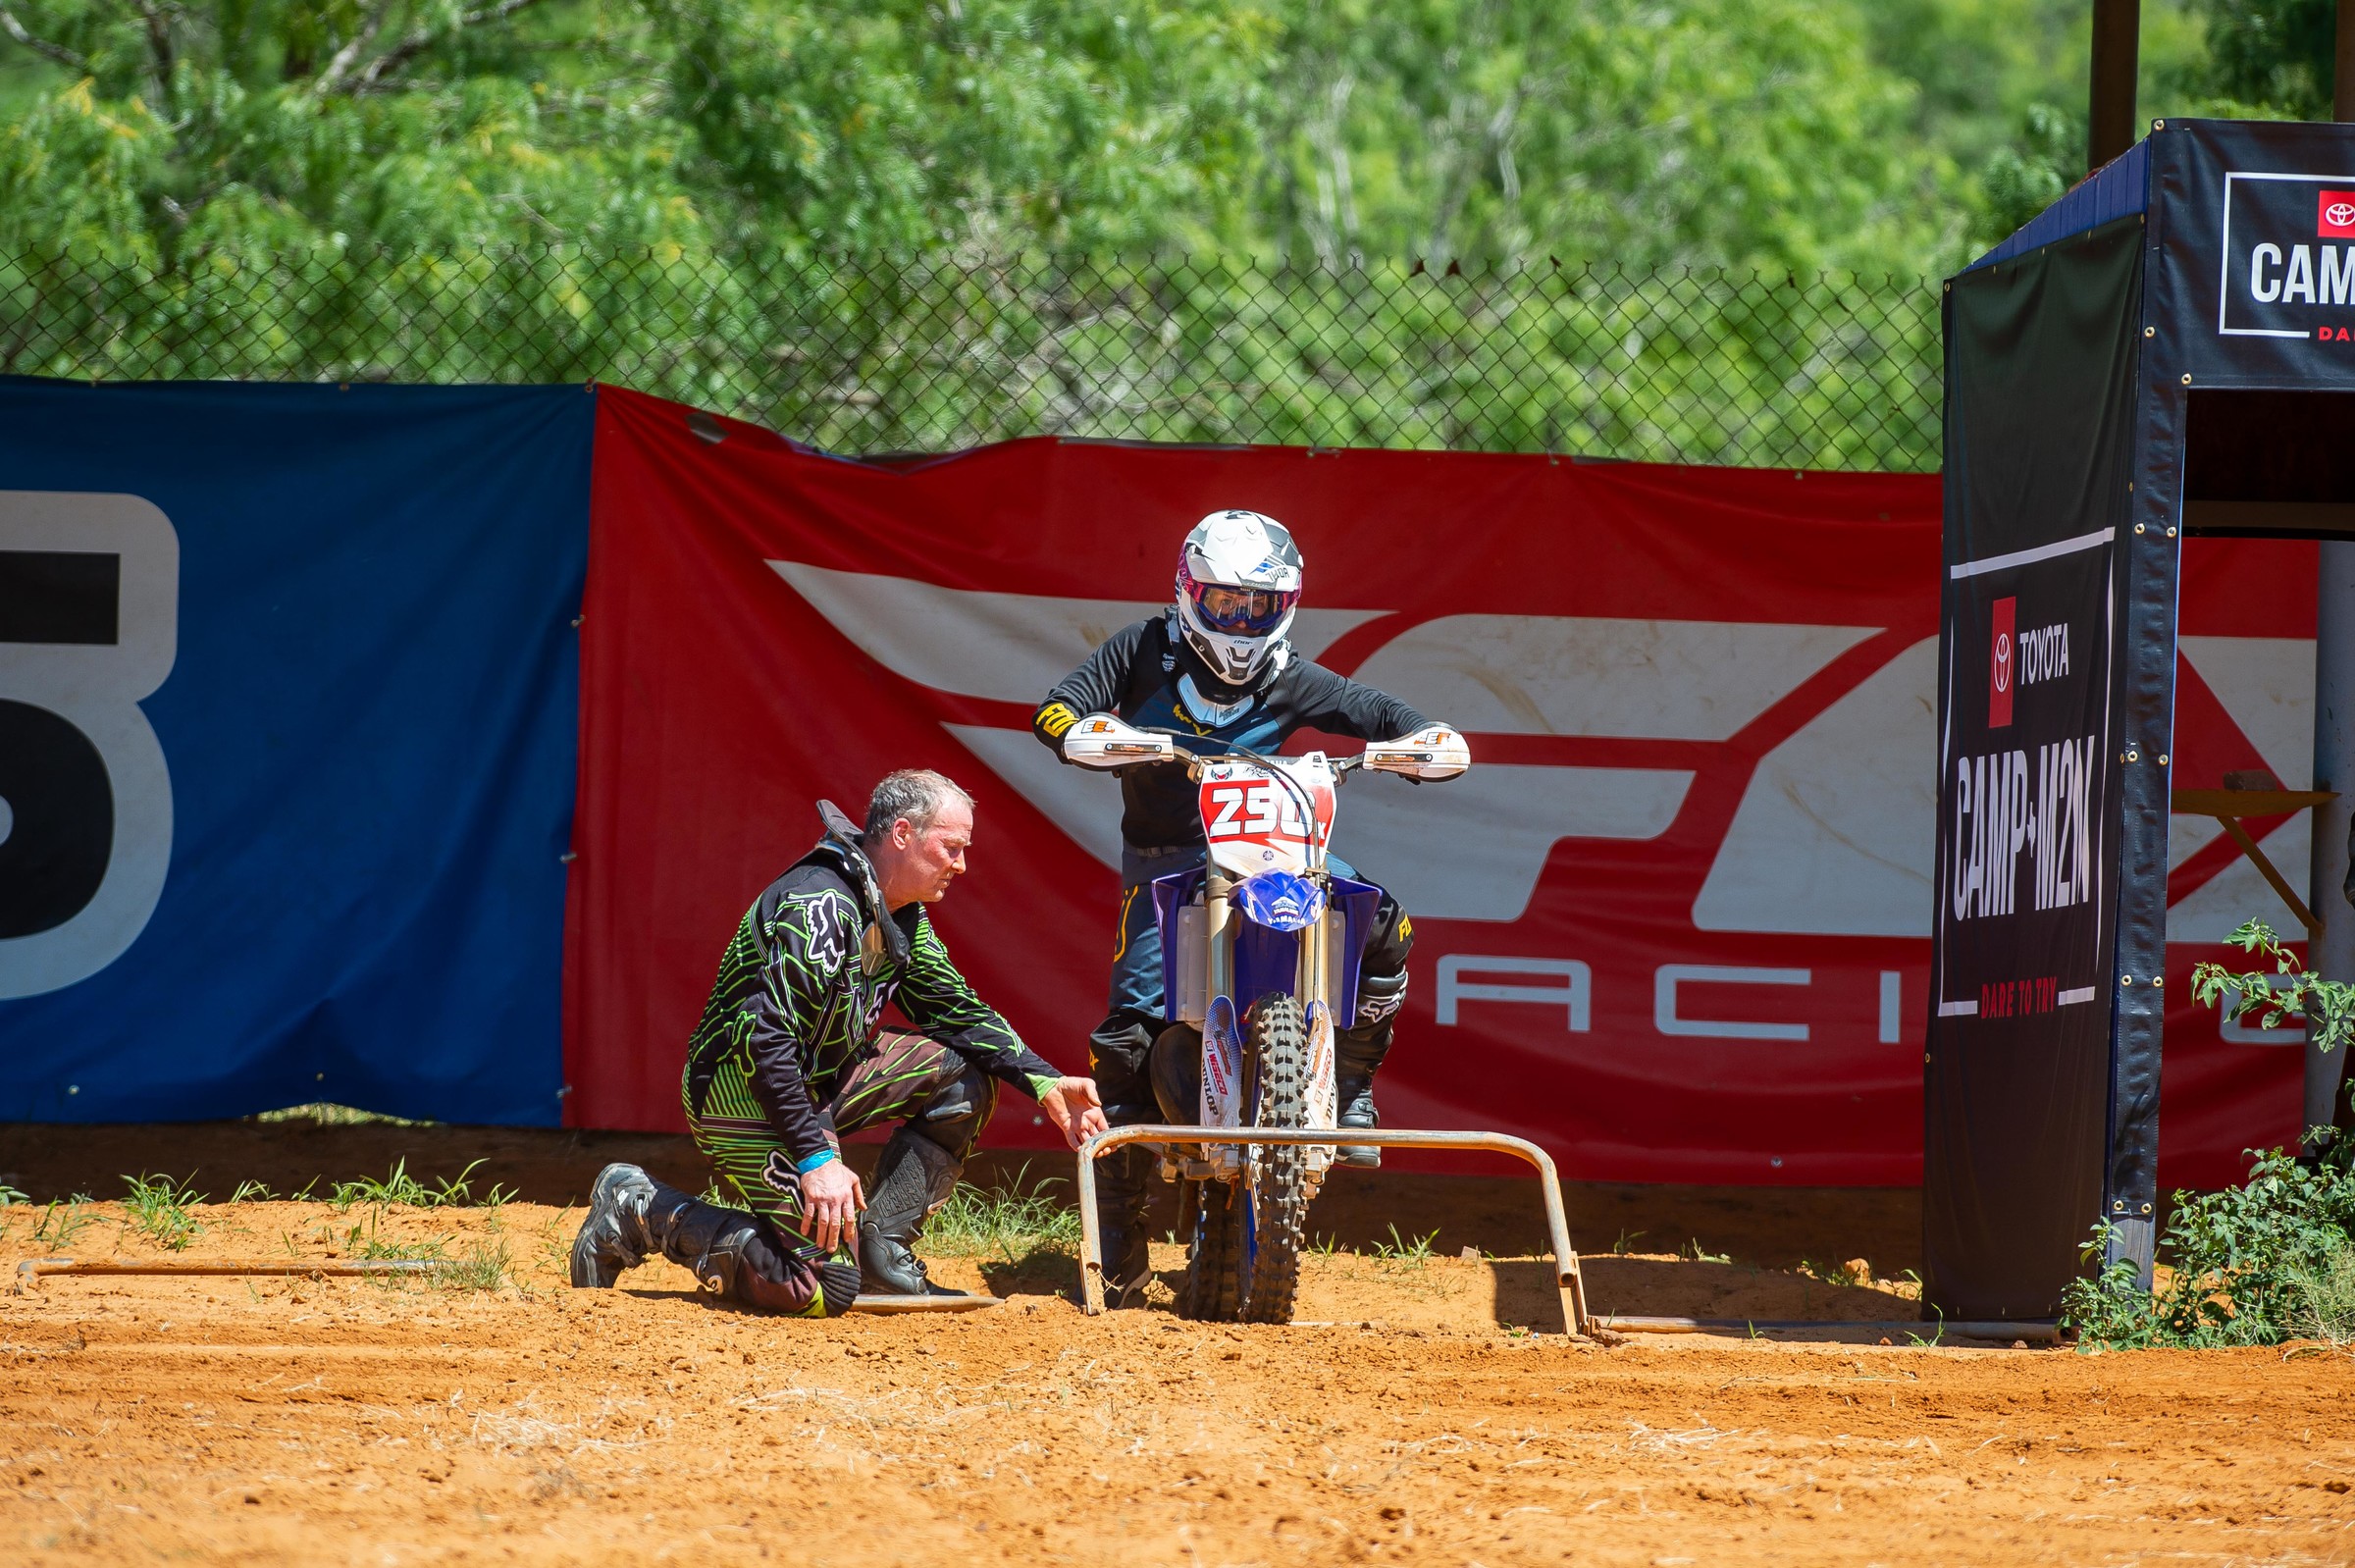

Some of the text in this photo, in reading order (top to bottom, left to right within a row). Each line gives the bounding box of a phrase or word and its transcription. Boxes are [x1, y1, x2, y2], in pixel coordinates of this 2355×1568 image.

[2319, 327, 2355, 341] DA
[2019, 622, 2069, 685] TOYOTA
[1209, 786, 1316, 839] 250
[1954, 750, 2028, 921] CAMP
[2035, 735, 2096, 912] M2N
[1980, 976, 2057, 1019] DARE TO TRY
[1208, 1053, 1229, 1096] WISECO
